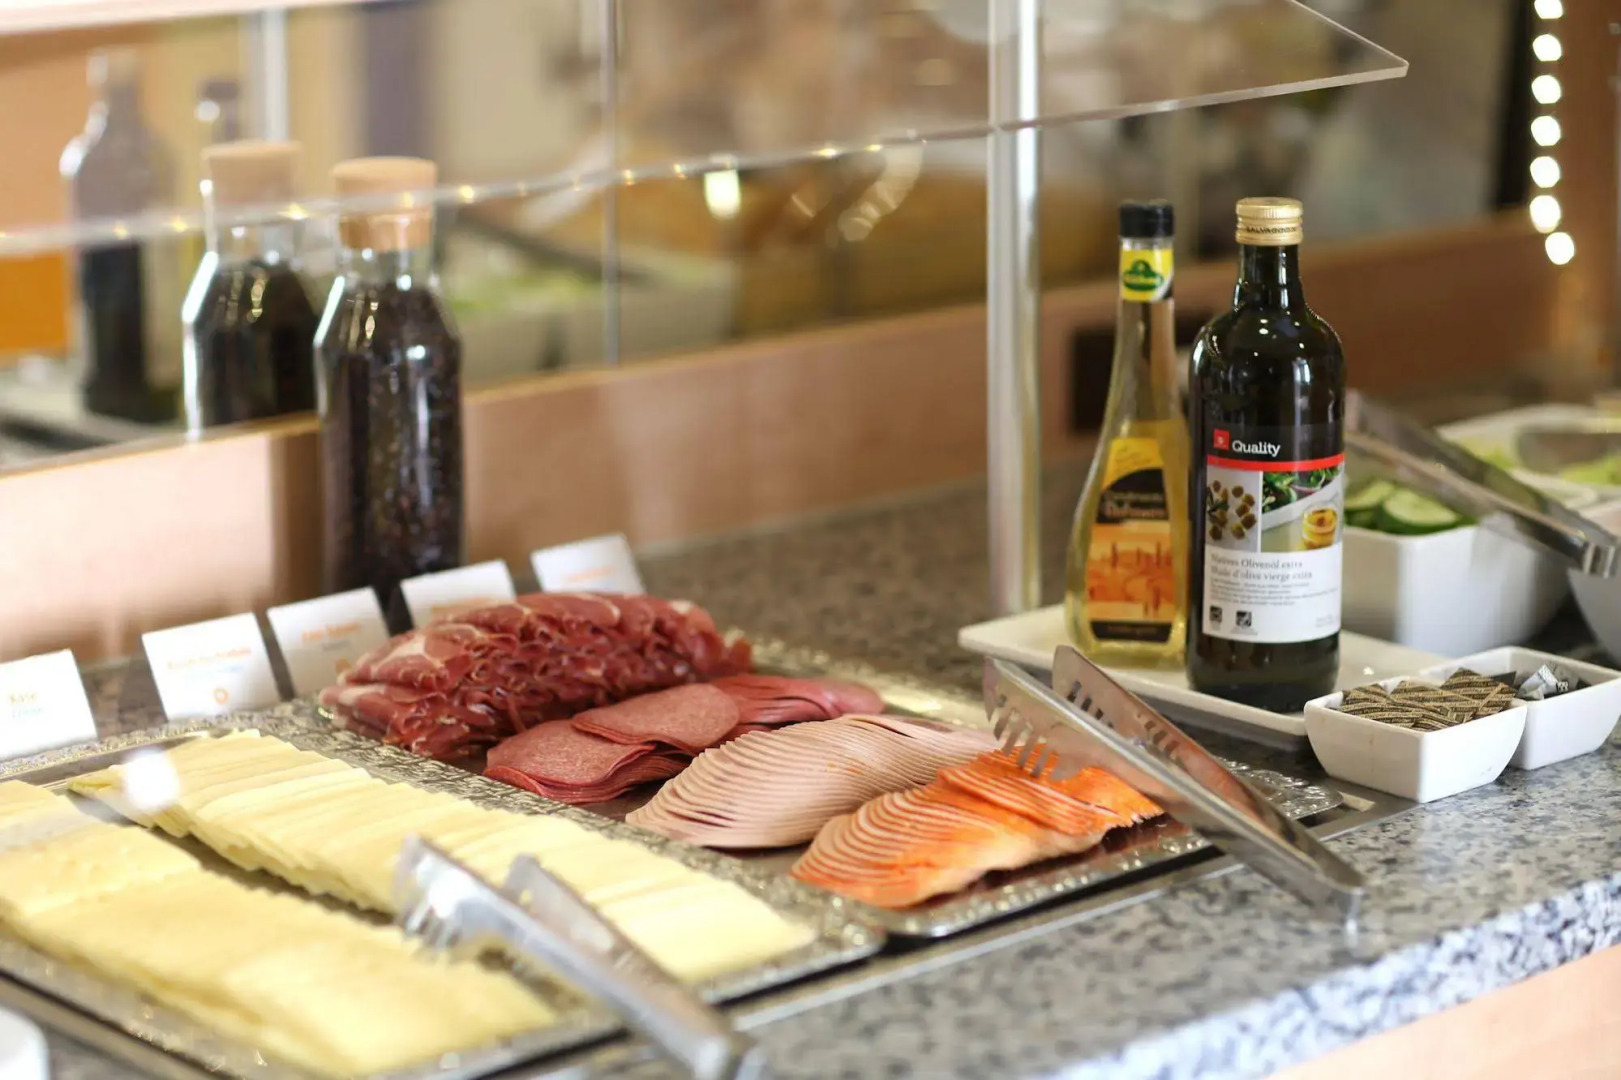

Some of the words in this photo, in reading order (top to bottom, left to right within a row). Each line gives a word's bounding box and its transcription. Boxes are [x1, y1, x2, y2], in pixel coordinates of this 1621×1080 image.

[1232, 439, 1281, 457] Quality
[1241, 558, 1280, 570] Olivenöl
[1263, 571, 1291, 583] vierge
